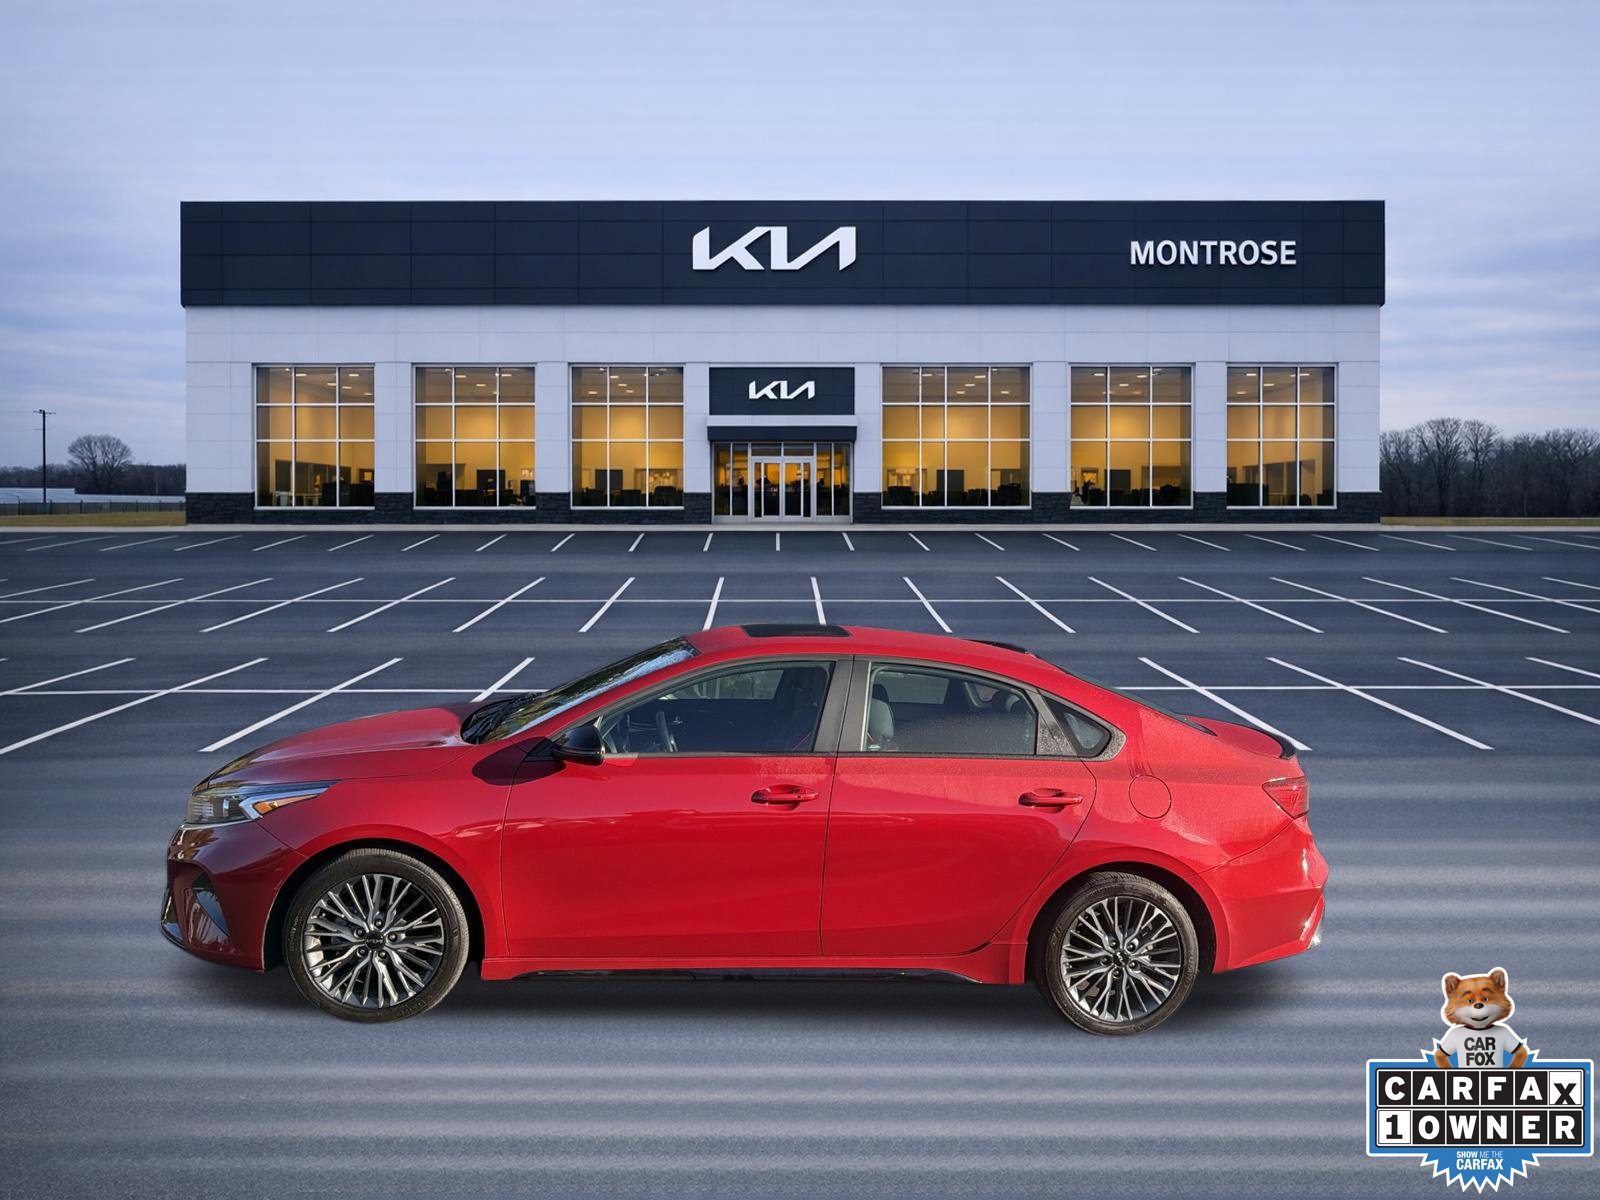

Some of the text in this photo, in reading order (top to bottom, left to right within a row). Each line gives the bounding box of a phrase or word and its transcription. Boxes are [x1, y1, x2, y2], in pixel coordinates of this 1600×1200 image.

[692, 226, 857, 271] KIA
[1130, 240, 1297, 266] MONTROSE
[748, 380, 816, 400] KIA
